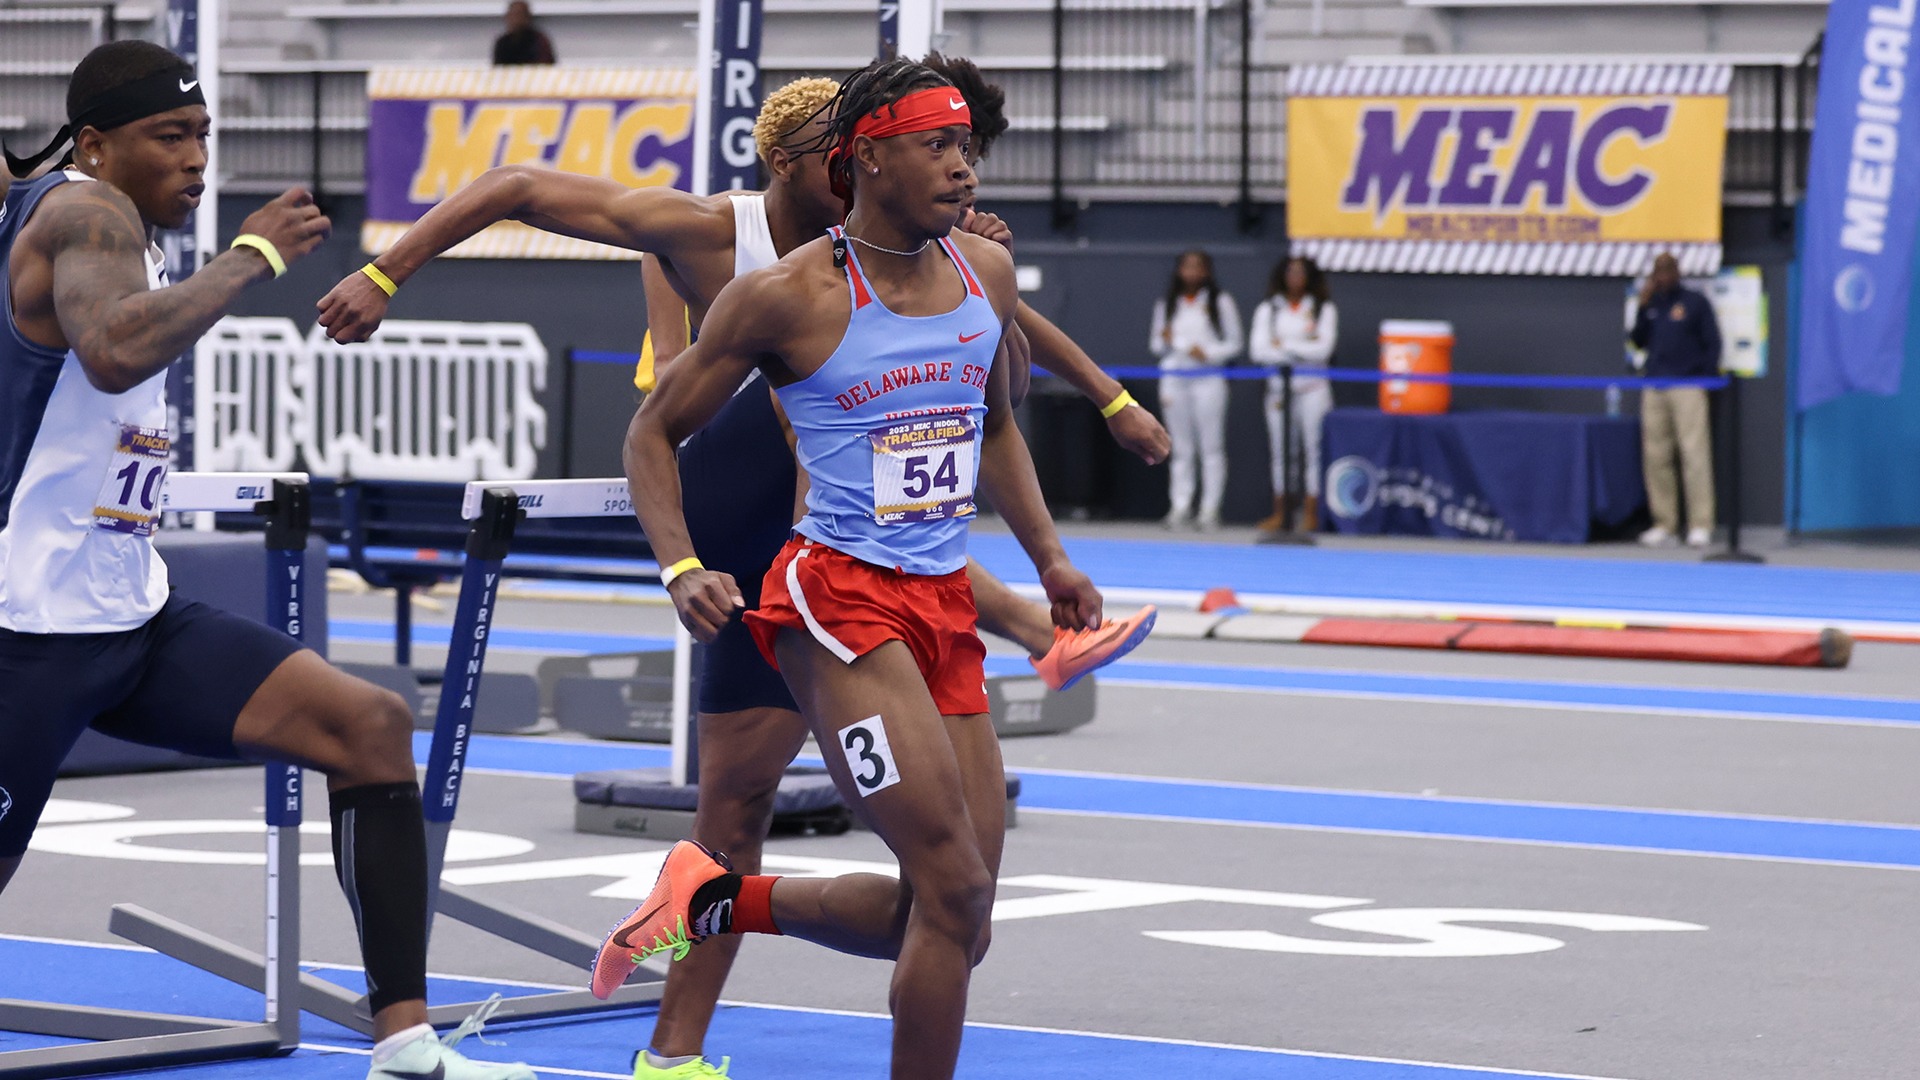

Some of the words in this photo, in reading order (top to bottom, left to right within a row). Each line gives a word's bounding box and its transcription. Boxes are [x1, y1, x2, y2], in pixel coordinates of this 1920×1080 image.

[721, 1, 757, 190] IRG
[1840, 0, 1917, 254] MEDICAL
[1341, 104, 1672, 224] MEAC
[834, 361, 953, 412] DELAWARE
[882, 431, 926, 447] TRACK
[927, 429, 935, 440] &
[936, 426, 966, 439] FIELD
[889, 425, 910, 435] 2023
[933, 419, 960, 429] INDOOR
[236, 486, 265, 500] GILL
[517, 495, 544, 508] GILL
[902, 451, 959, 499] 54
[460, 573, 496, 709] VIRGINIA
[442, 724, 466, 808] BEACH
[845, 727, 886, 789] 3
